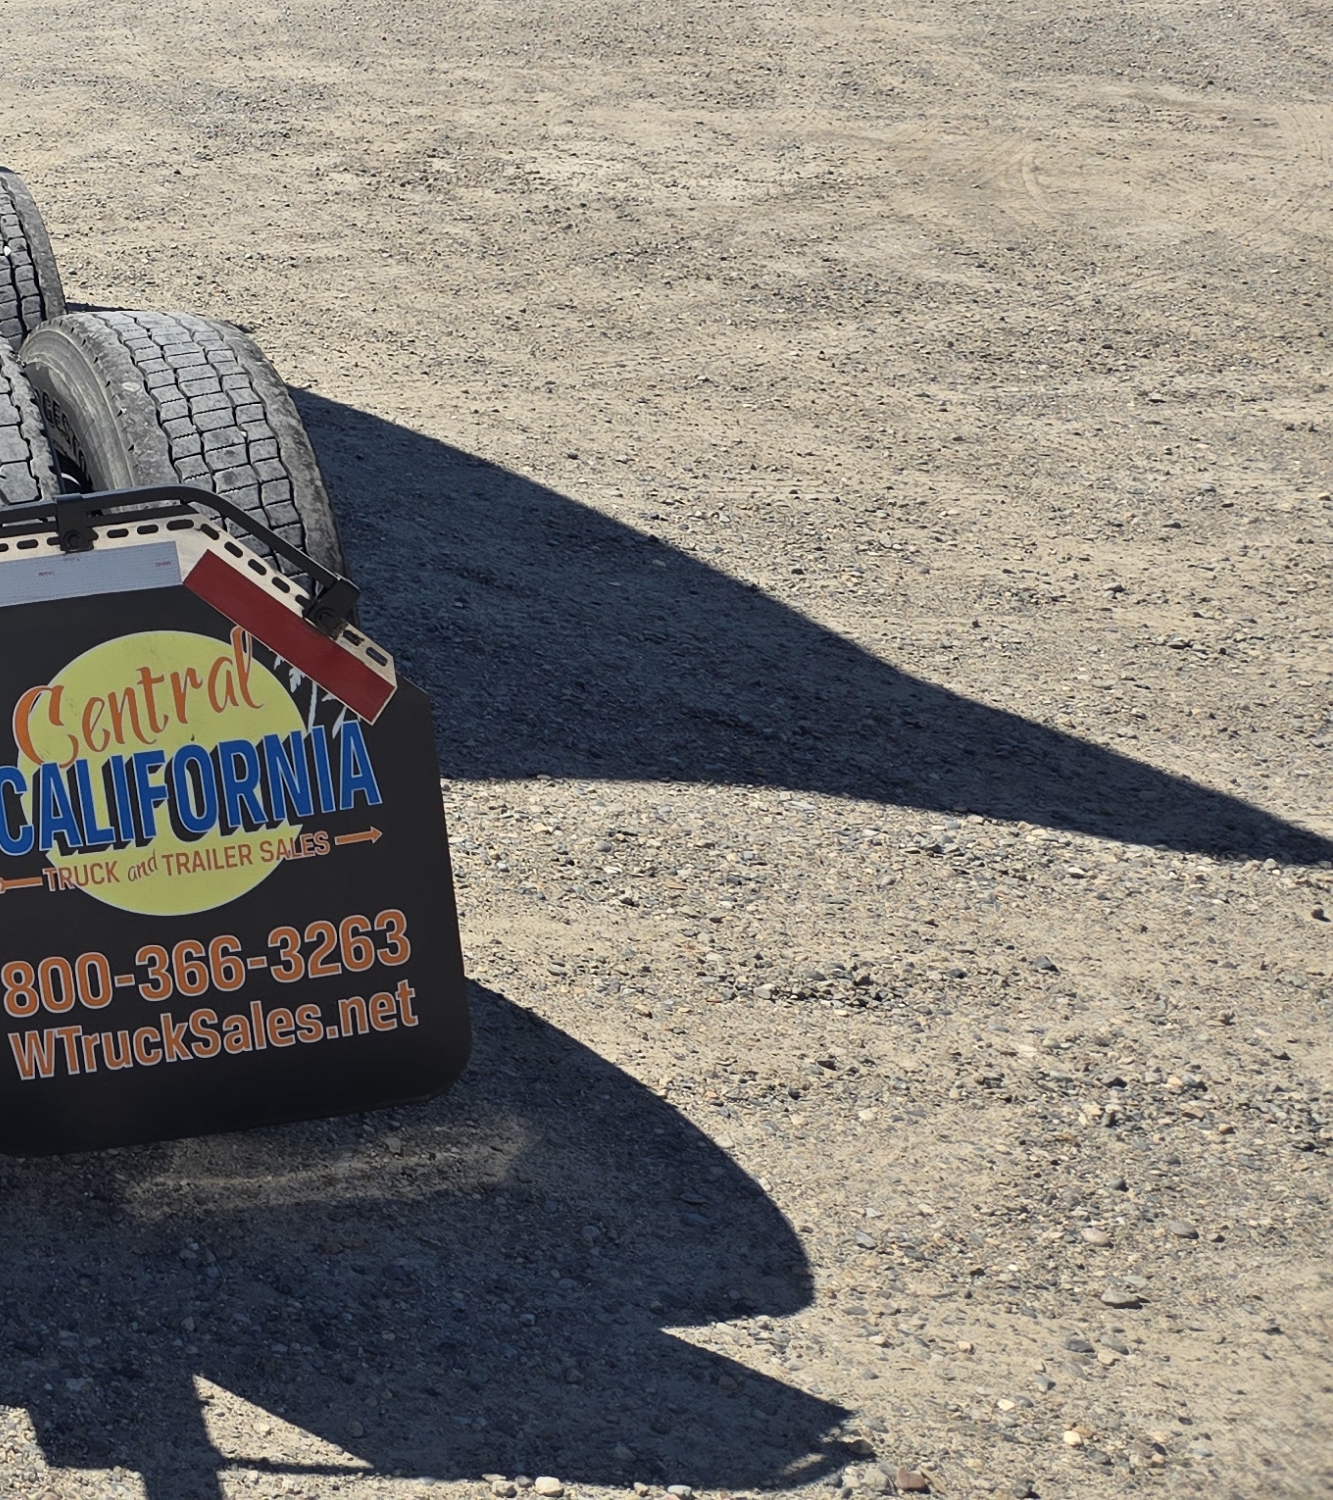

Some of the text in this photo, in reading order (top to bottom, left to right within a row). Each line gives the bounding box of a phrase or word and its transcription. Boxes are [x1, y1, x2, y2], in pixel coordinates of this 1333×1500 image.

[13, 625, 265, 768] Central
[42, 830, 331, 892] TRUCK and TRAILER SALES
[0, 909, 412, 1018] 800-366-3263
[7, 979, 419, 1081] WTruckSales.net
